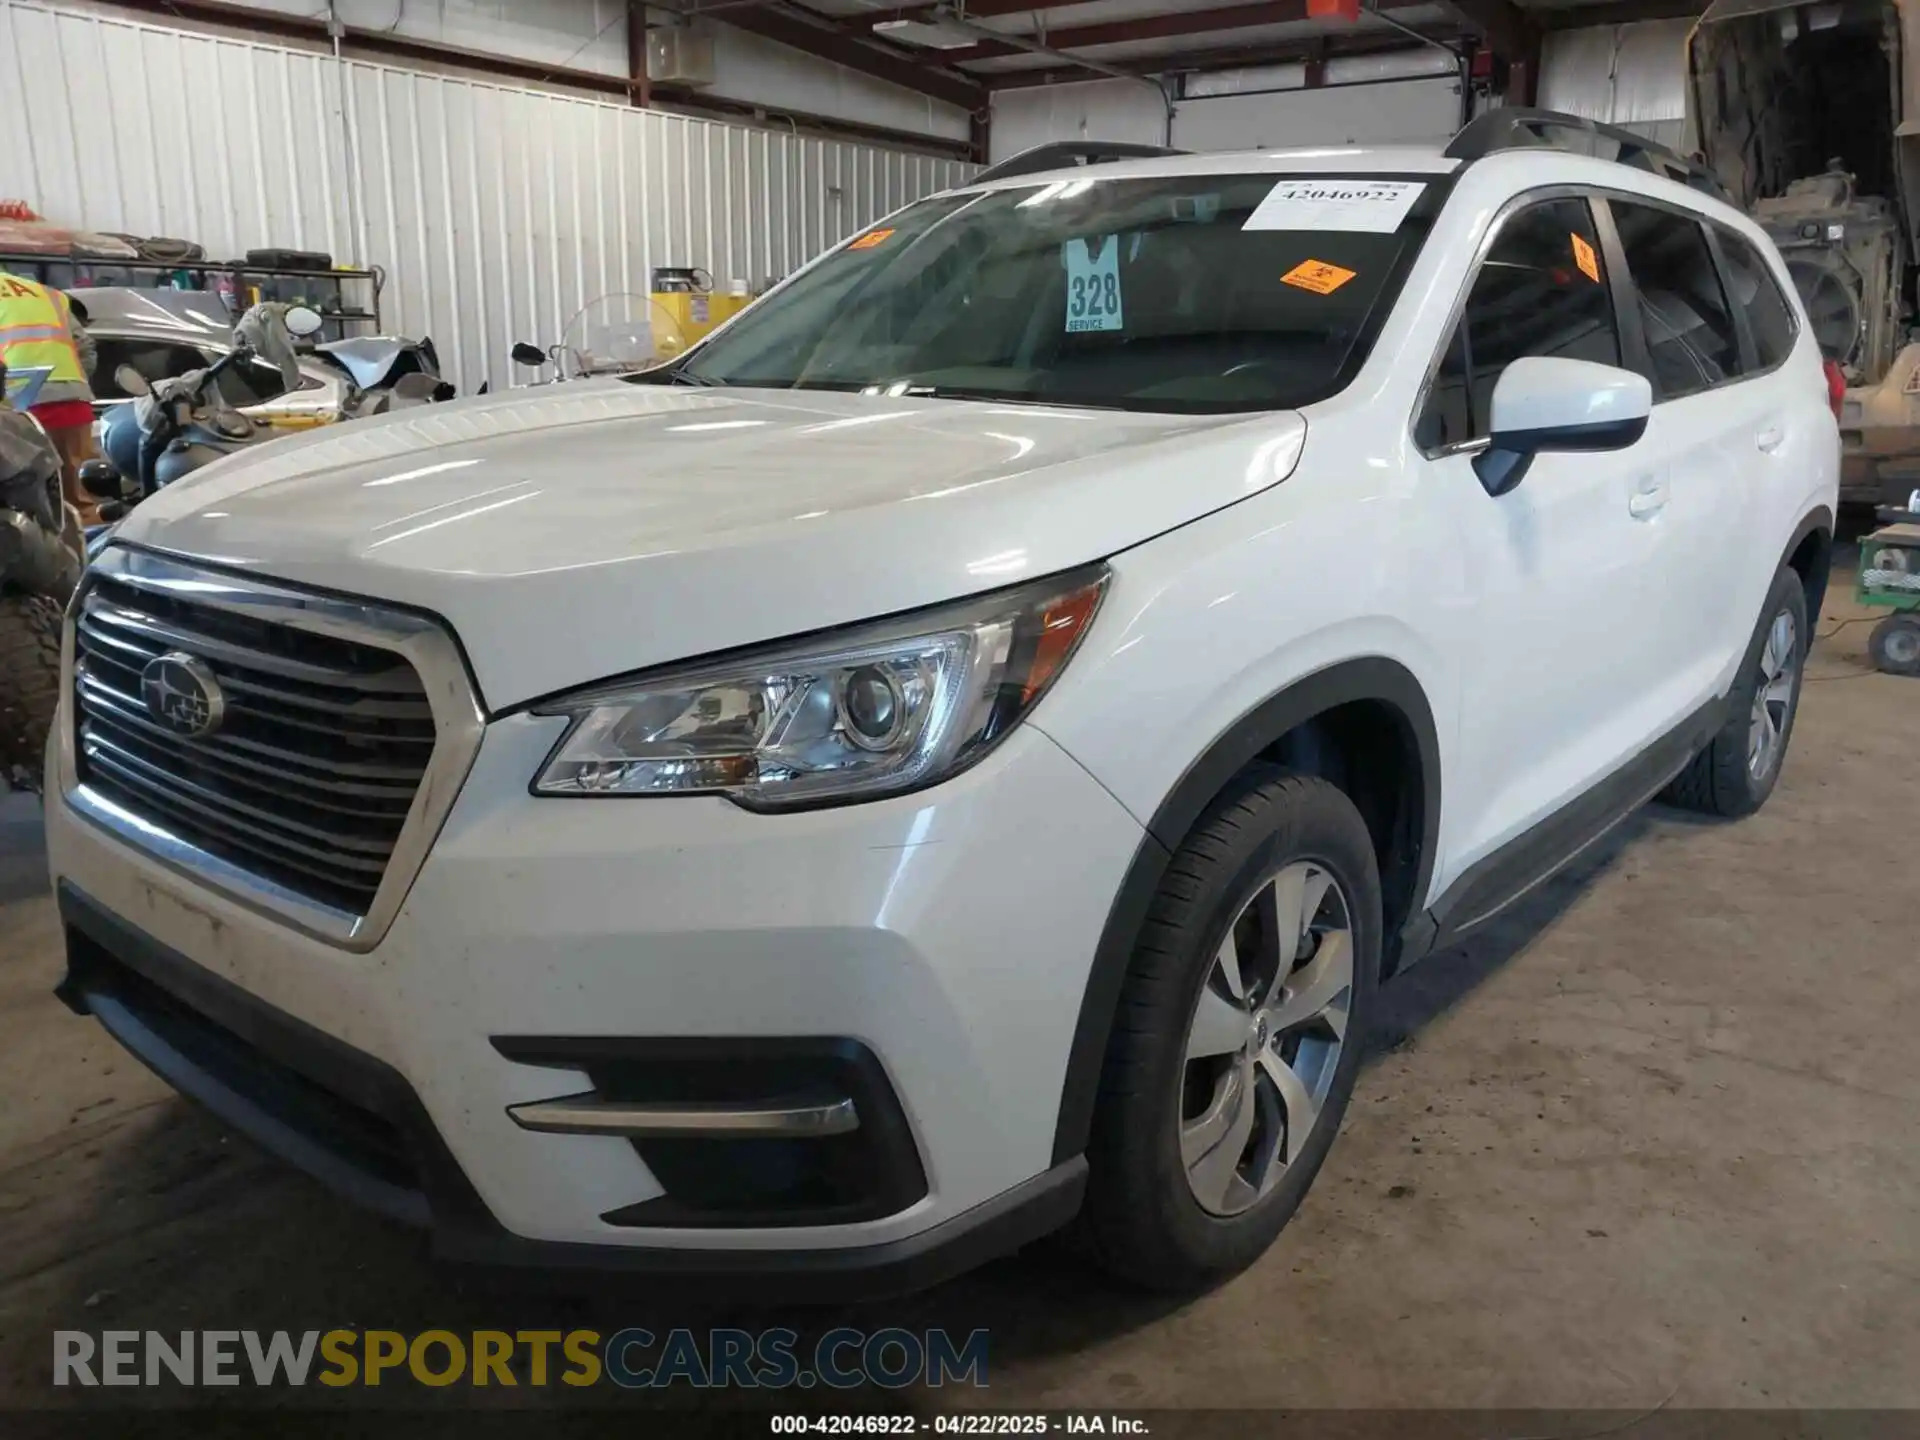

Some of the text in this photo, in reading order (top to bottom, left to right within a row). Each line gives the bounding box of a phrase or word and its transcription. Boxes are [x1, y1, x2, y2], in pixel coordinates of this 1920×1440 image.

[1282, 189, 1399, 202] 42046922
[1070, 272, 1118, 317] 328
[1068, 319, 1104, 331] SERVICE
